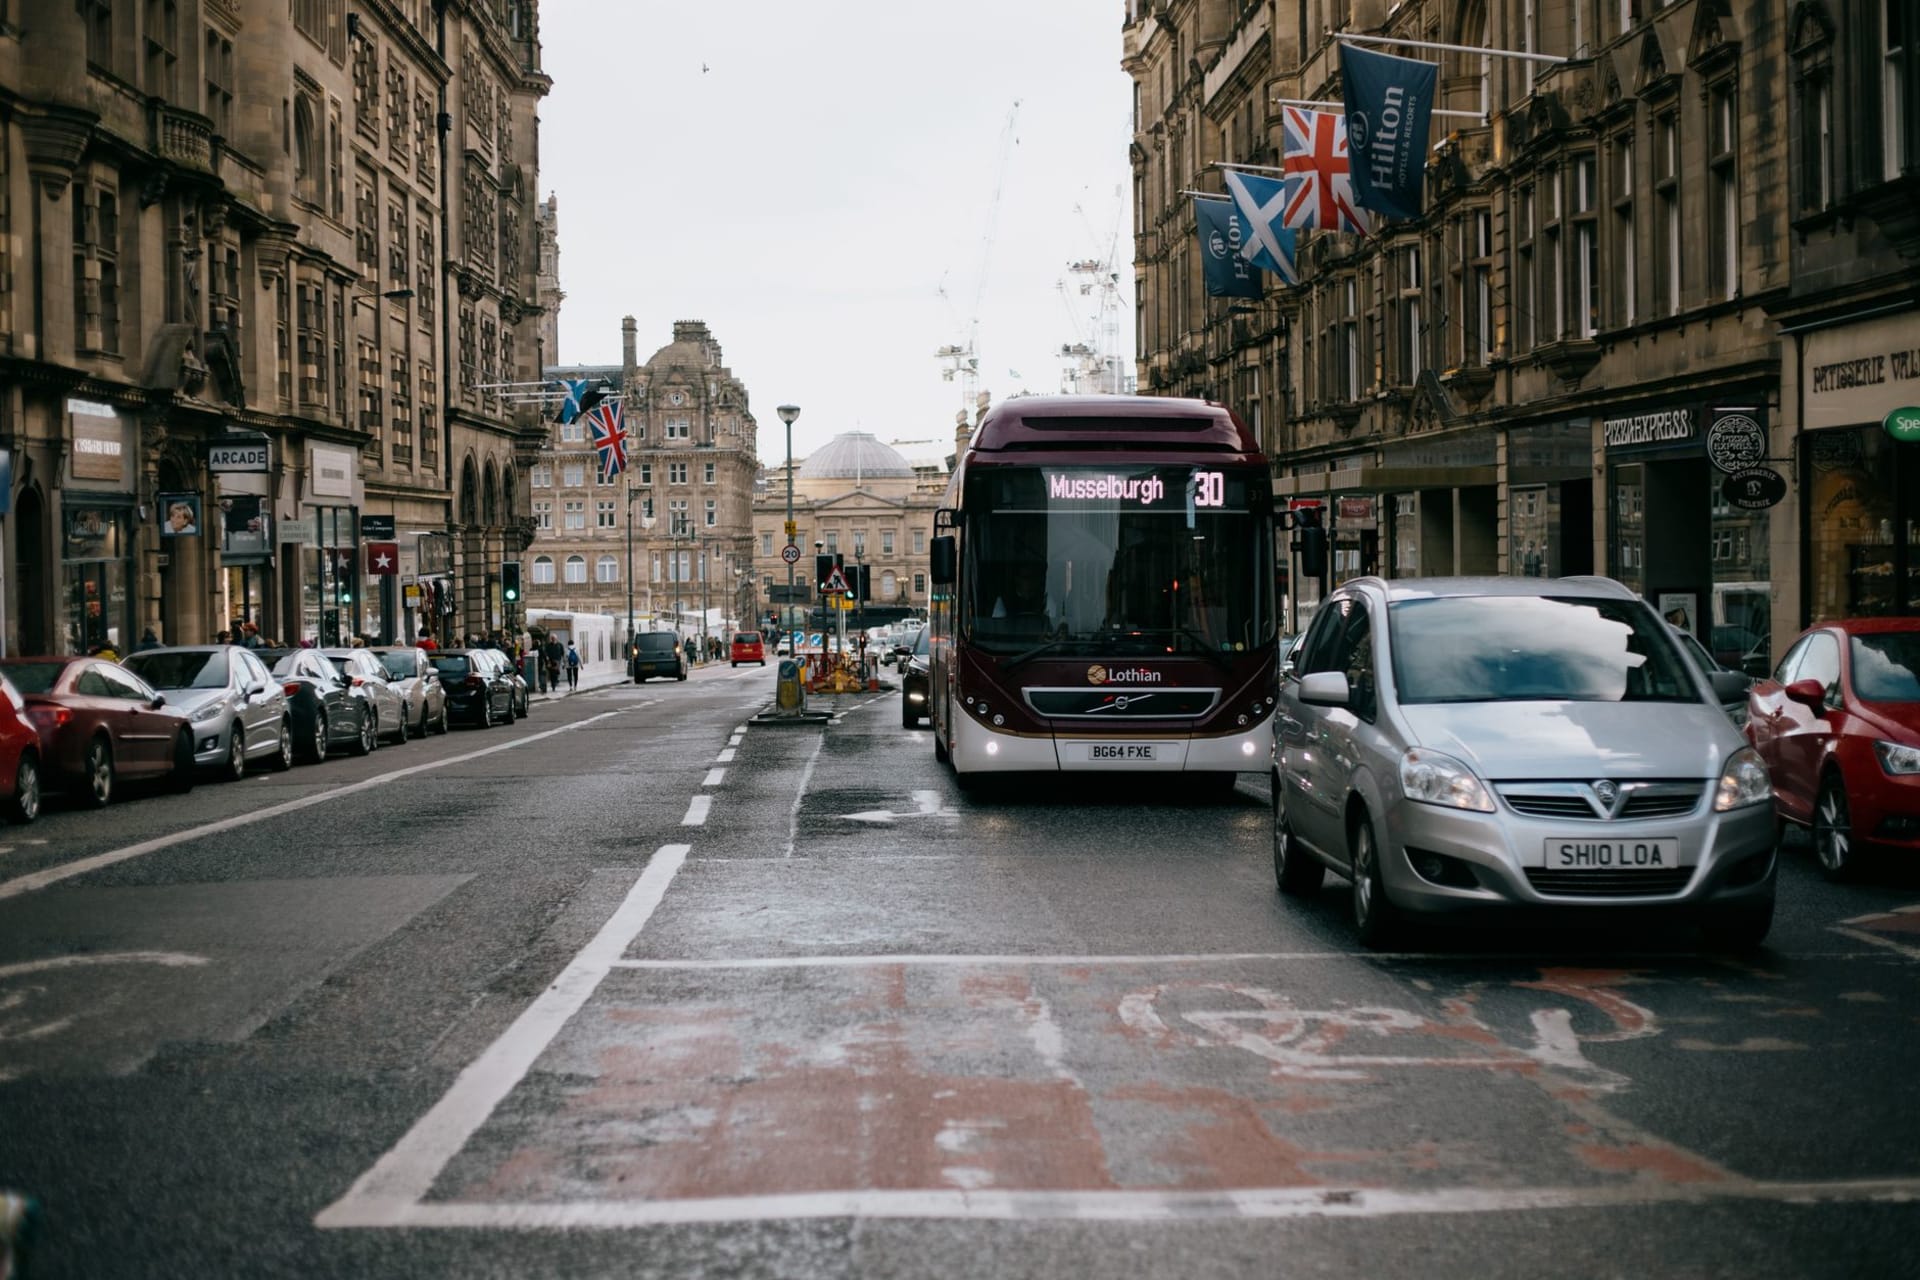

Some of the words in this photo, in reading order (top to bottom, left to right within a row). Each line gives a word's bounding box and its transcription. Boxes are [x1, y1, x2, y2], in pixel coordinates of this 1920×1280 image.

[1371, 86, 1404, 190] Hilton
[1399, 150, 1409, 187] HOTELS
[1404, 95, 1417, 138] RESORTS
[1813, 354, 1885, 393] PATISSERIE
[1890, 348, 1920, 380] VAL
[1603, 409, 1689, 447] PIZZAEXPRESS
[1722, 434, 1750, 443] PIZZA
[211, 451, 265, 465] ARCADE
[1050, 474, 1164, 505] Musselburgh
[1195, 471, 1224, 506] 30
[784, 550, 797, 558] 20
[1109, 668, 1161, 682] Lothian
[1093, 746, 1124, 758] BG64
[1127, 746, 1152, 758] FXE
[1619, 844, 1663, 865] LOA
